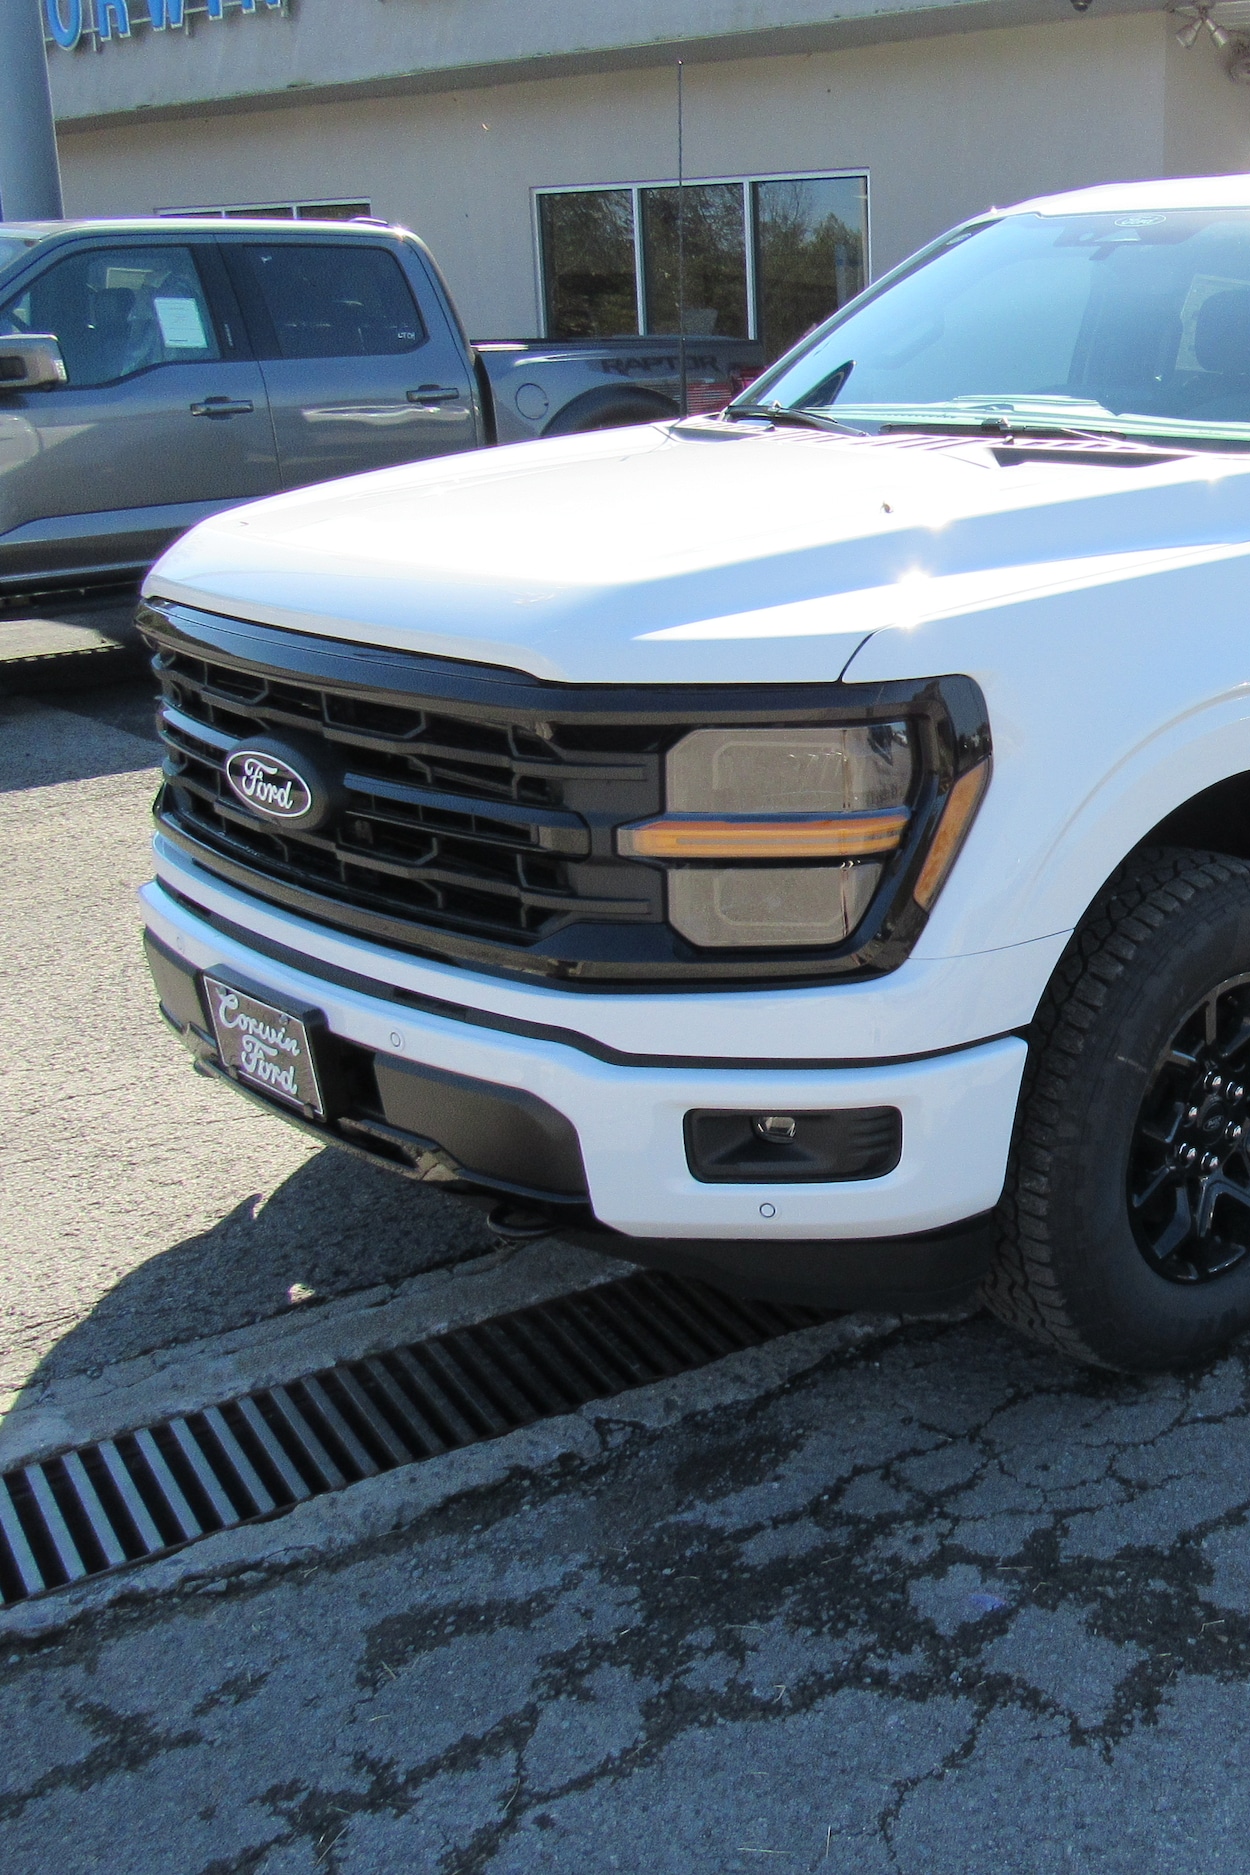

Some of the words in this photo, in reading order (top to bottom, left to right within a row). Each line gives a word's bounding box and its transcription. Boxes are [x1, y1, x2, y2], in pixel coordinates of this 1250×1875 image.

[601, 355, 724, 376] RAPTOR
[242, 758, 293, 809] Ford
[215, 986, 300, 1057] Corwin
[241, 1034, 298, 1095] Ford
